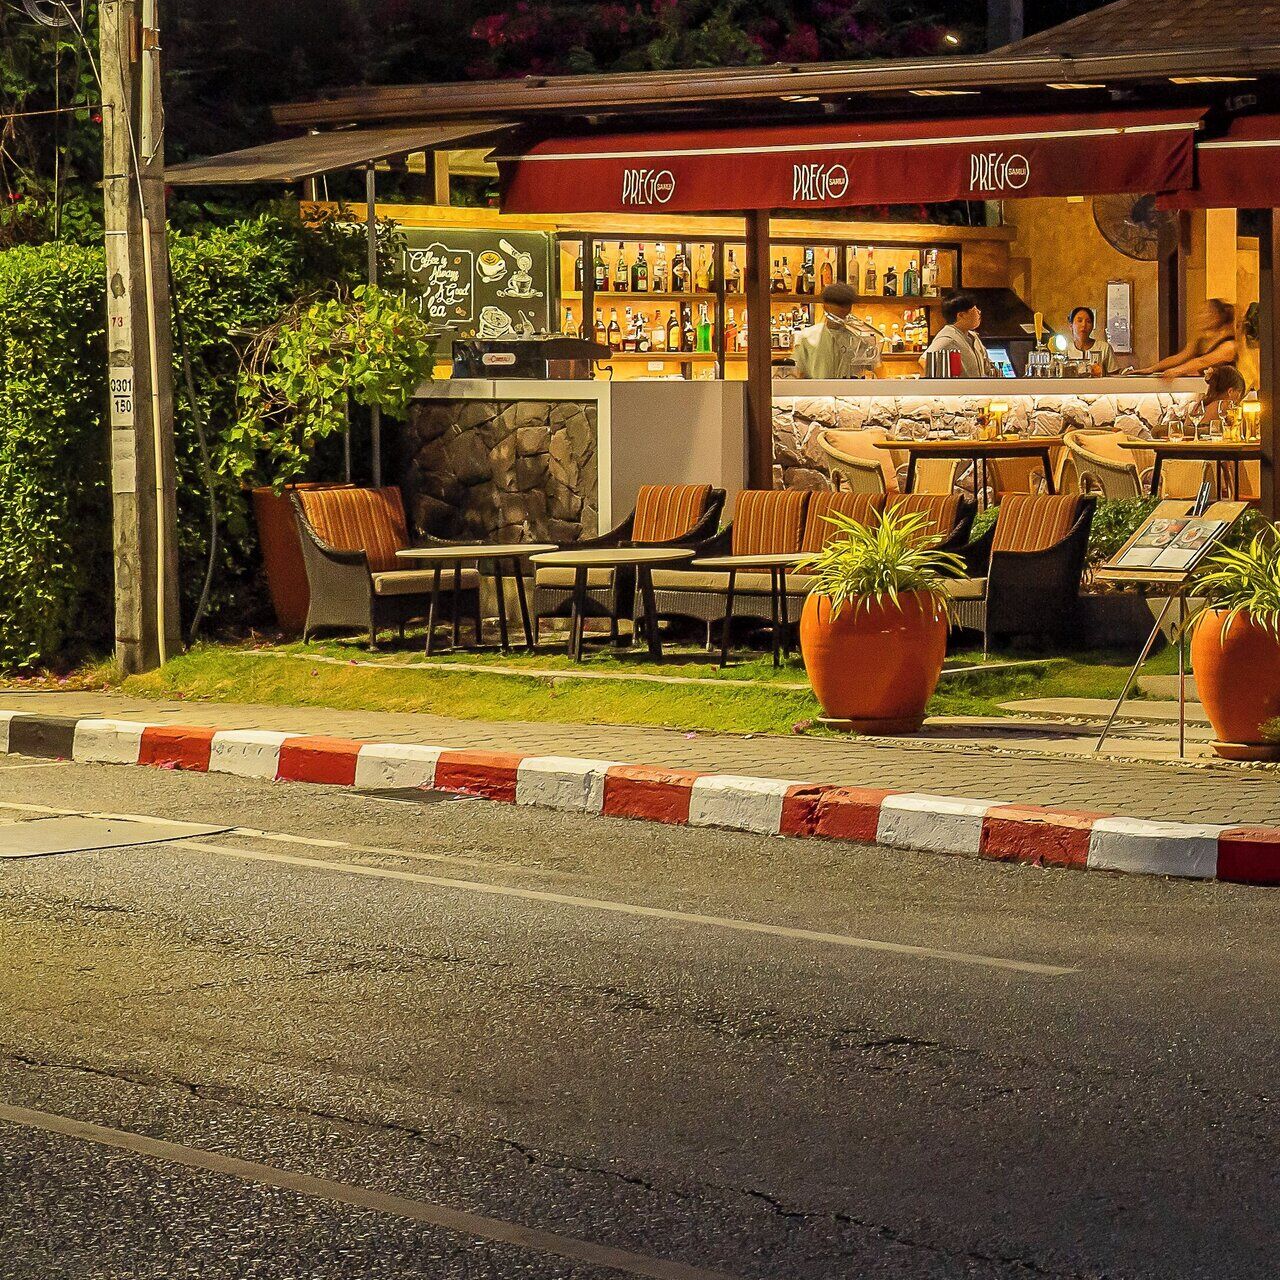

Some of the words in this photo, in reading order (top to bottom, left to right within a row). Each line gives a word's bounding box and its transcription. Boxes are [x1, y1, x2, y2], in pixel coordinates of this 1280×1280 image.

[792, 164, 849, 200] PREGO
[969, 153, 1030, 191] PREGO
[622, 169, 676, 205] PREGO
[409, 251, 440, 272] Coffee
[110, 379, 132, 392] 0301
[115, 400, 132, 413] 150
